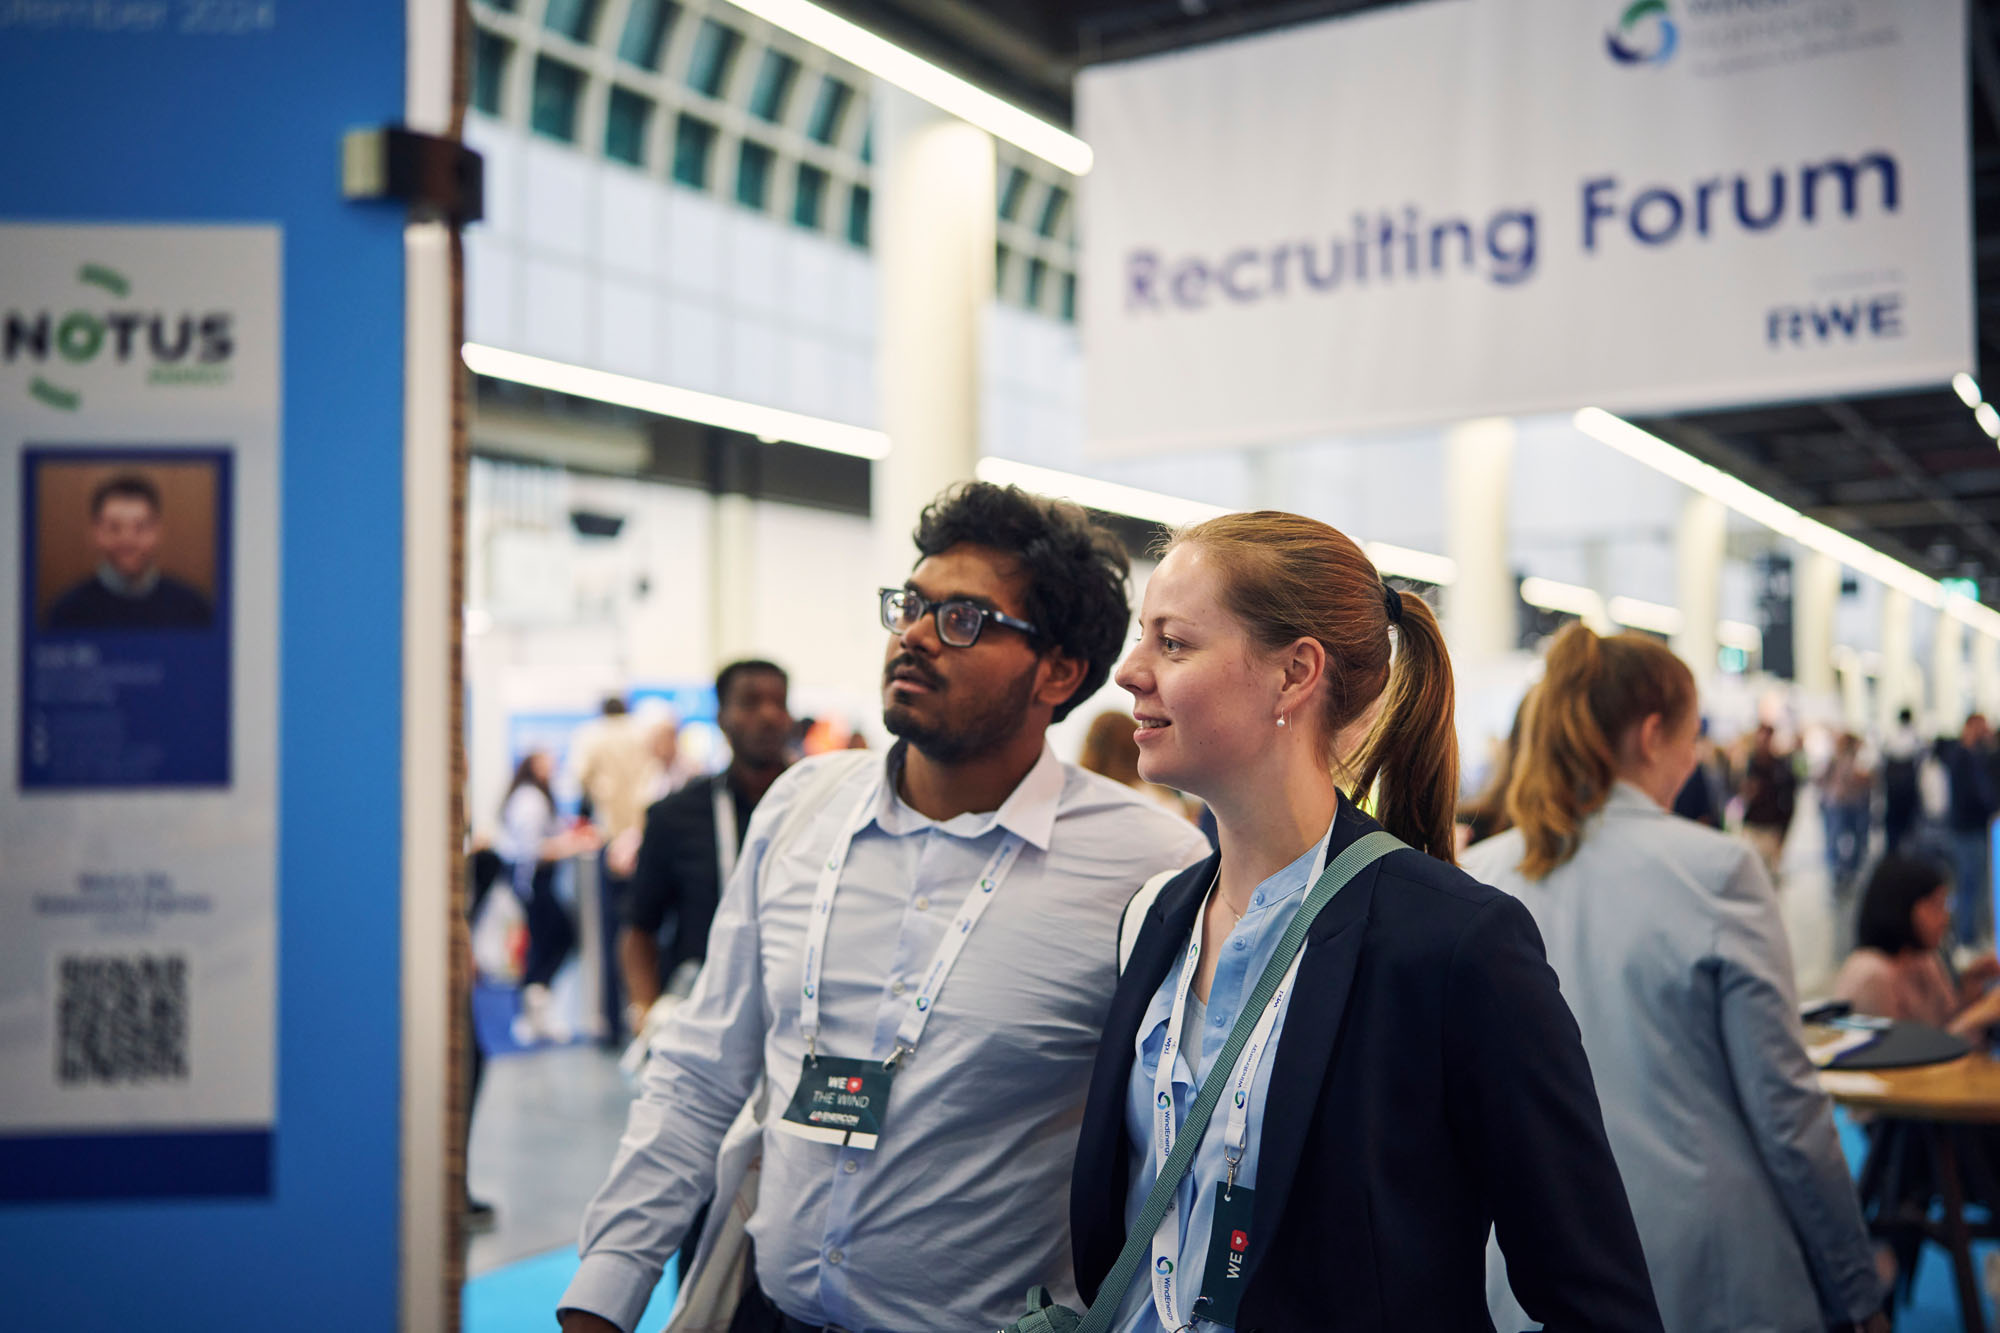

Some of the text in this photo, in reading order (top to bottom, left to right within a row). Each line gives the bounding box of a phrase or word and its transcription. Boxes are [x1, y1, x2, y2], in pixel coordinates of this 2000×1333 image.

[1125, 150, 1901, 312] Recruiting Forum
[3, 311, 235, 363] NOTUS
[1766, 293, 1903, 347] RWE
[813, 1090, 870, 1108] THE WIND
[828, 1076, 848, 1090] WE
[1226, 1251, 1243, 1278] WE
[1164, 1277, 1174, 1321] WindEnergy
